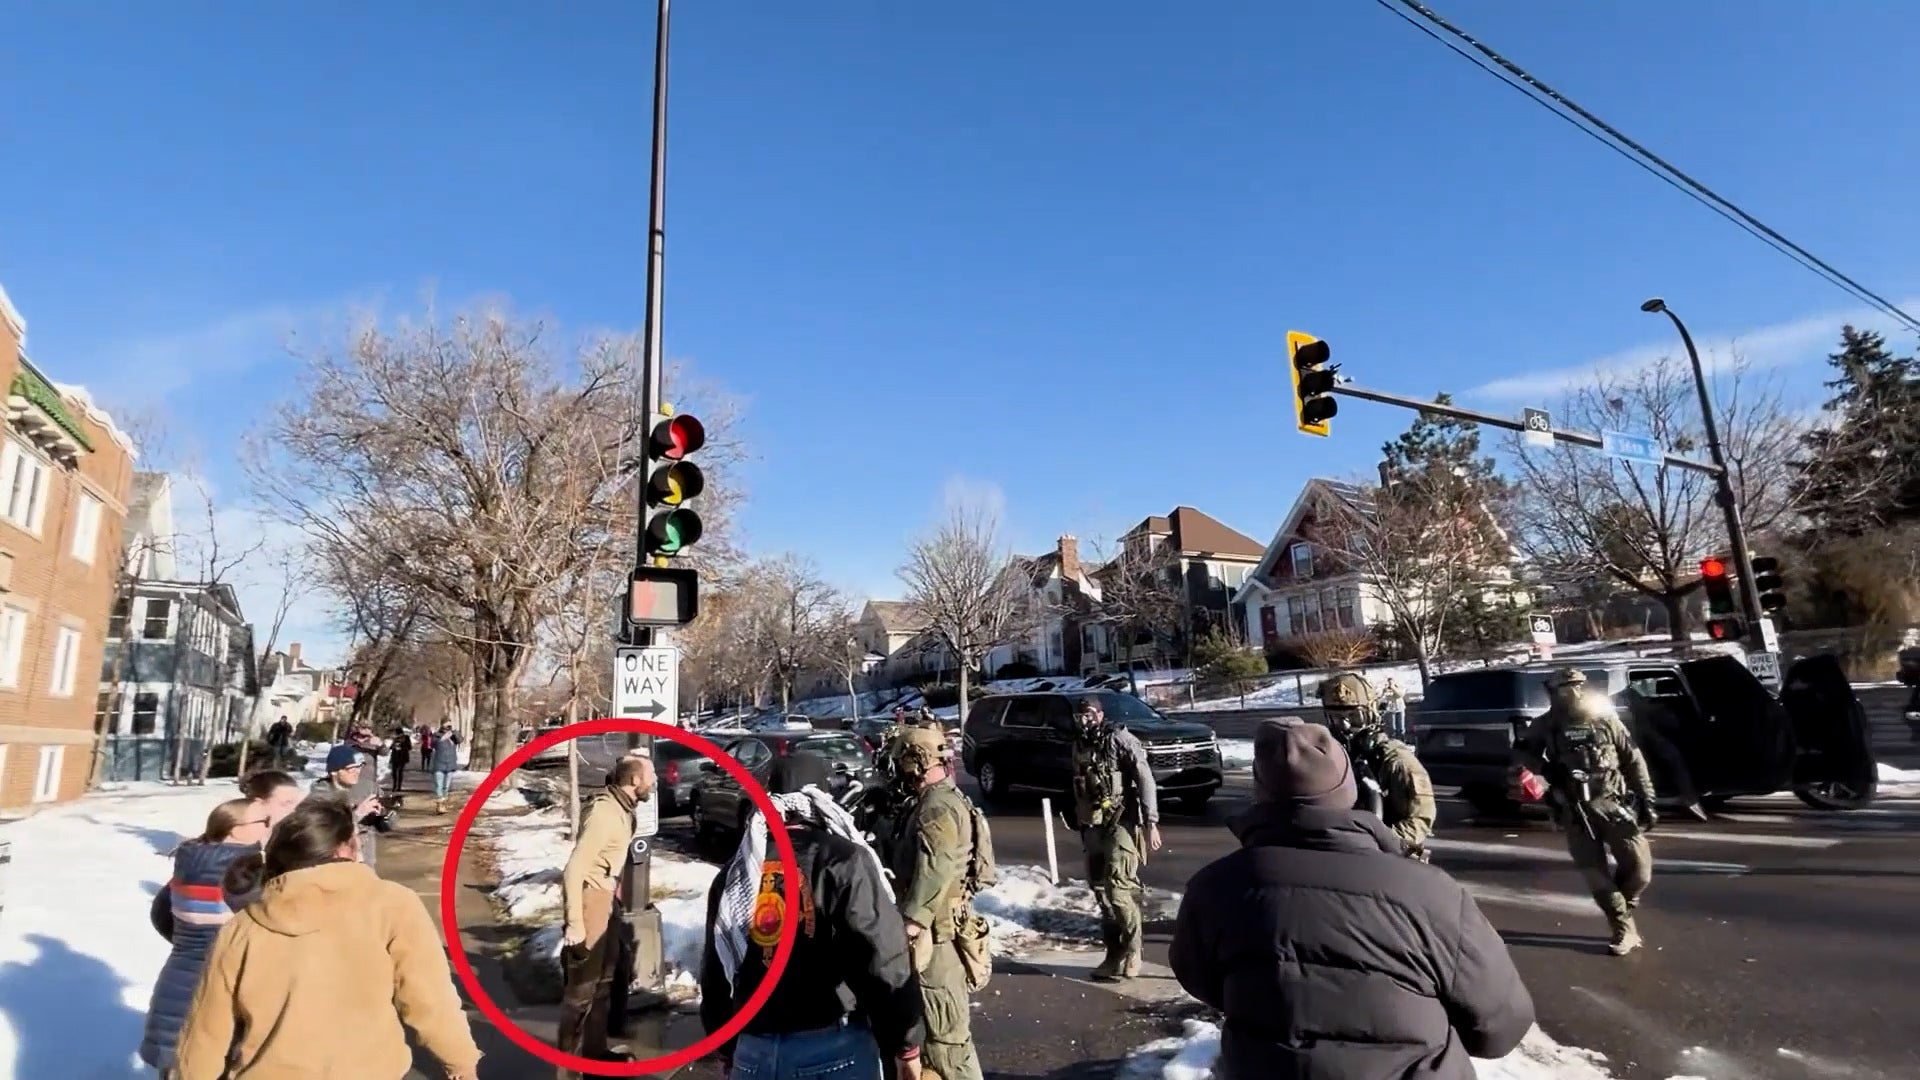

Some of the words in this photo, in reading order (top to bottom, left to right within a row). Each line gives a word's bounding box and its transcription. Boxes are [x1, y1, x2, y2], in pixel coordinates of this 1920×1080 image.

[626, 654, 668, 672] ONE
[1750, 655, 1772, 664] ONE
[1752, 664, 1774, 673] WAY
[624, 677, 668, 694] WAY
